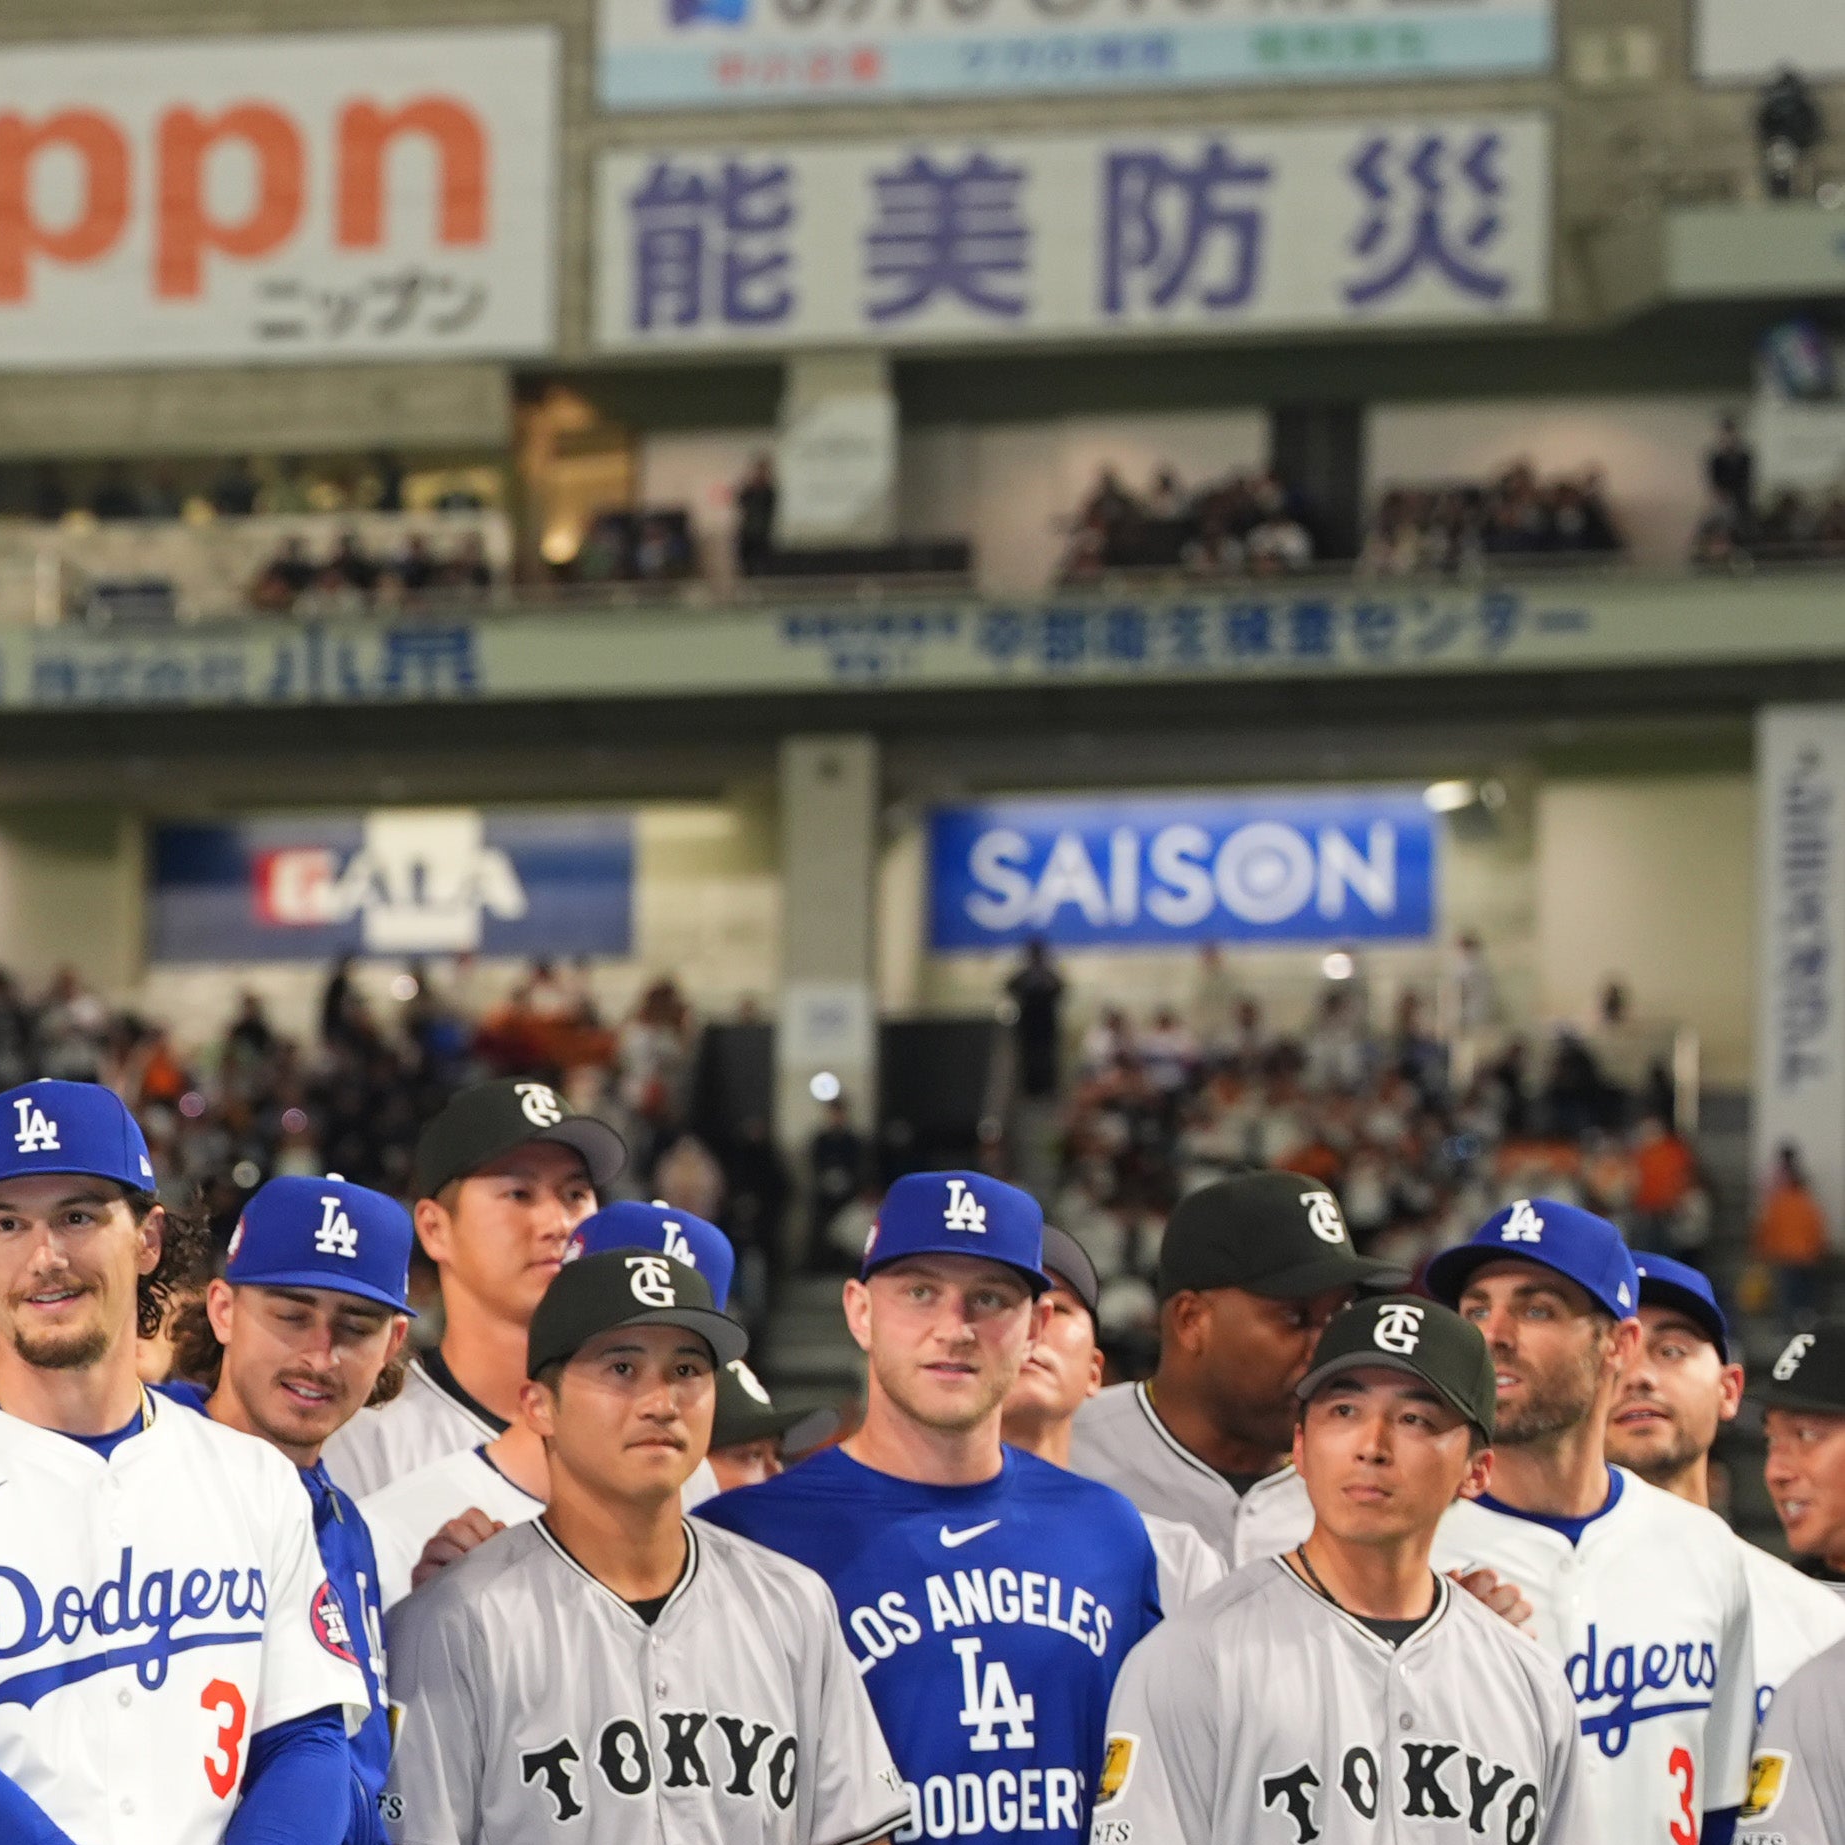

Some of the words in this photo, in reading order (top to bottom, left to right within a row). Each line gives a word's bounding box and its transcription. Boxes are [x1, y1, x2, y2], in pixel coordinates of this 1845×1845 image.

[623, 128, 1513, 336] 能美防災
[251, 268, 489, 341] ニップン
[963, 819, 1398, 929] SAISON
[11, 1096, 62, 1153] LA
[314, 1196, 359, 1259] LA
[943, 1179, 988, 1234] LA
[1500, 1199, 1545, 1243] LA
[850, 1590, 922, 1677] LOS
[923, 1566, 1114, 1658] ANGELES
[200, 1677, 247, 1799] 3
[951, 1636, 1036, 1753] LA
[1565, 1623, 1716, 1758] dgers
[521, 1708, 799, 1826] TOKYO
[893, 1767, 1086, 1843] DODGER
